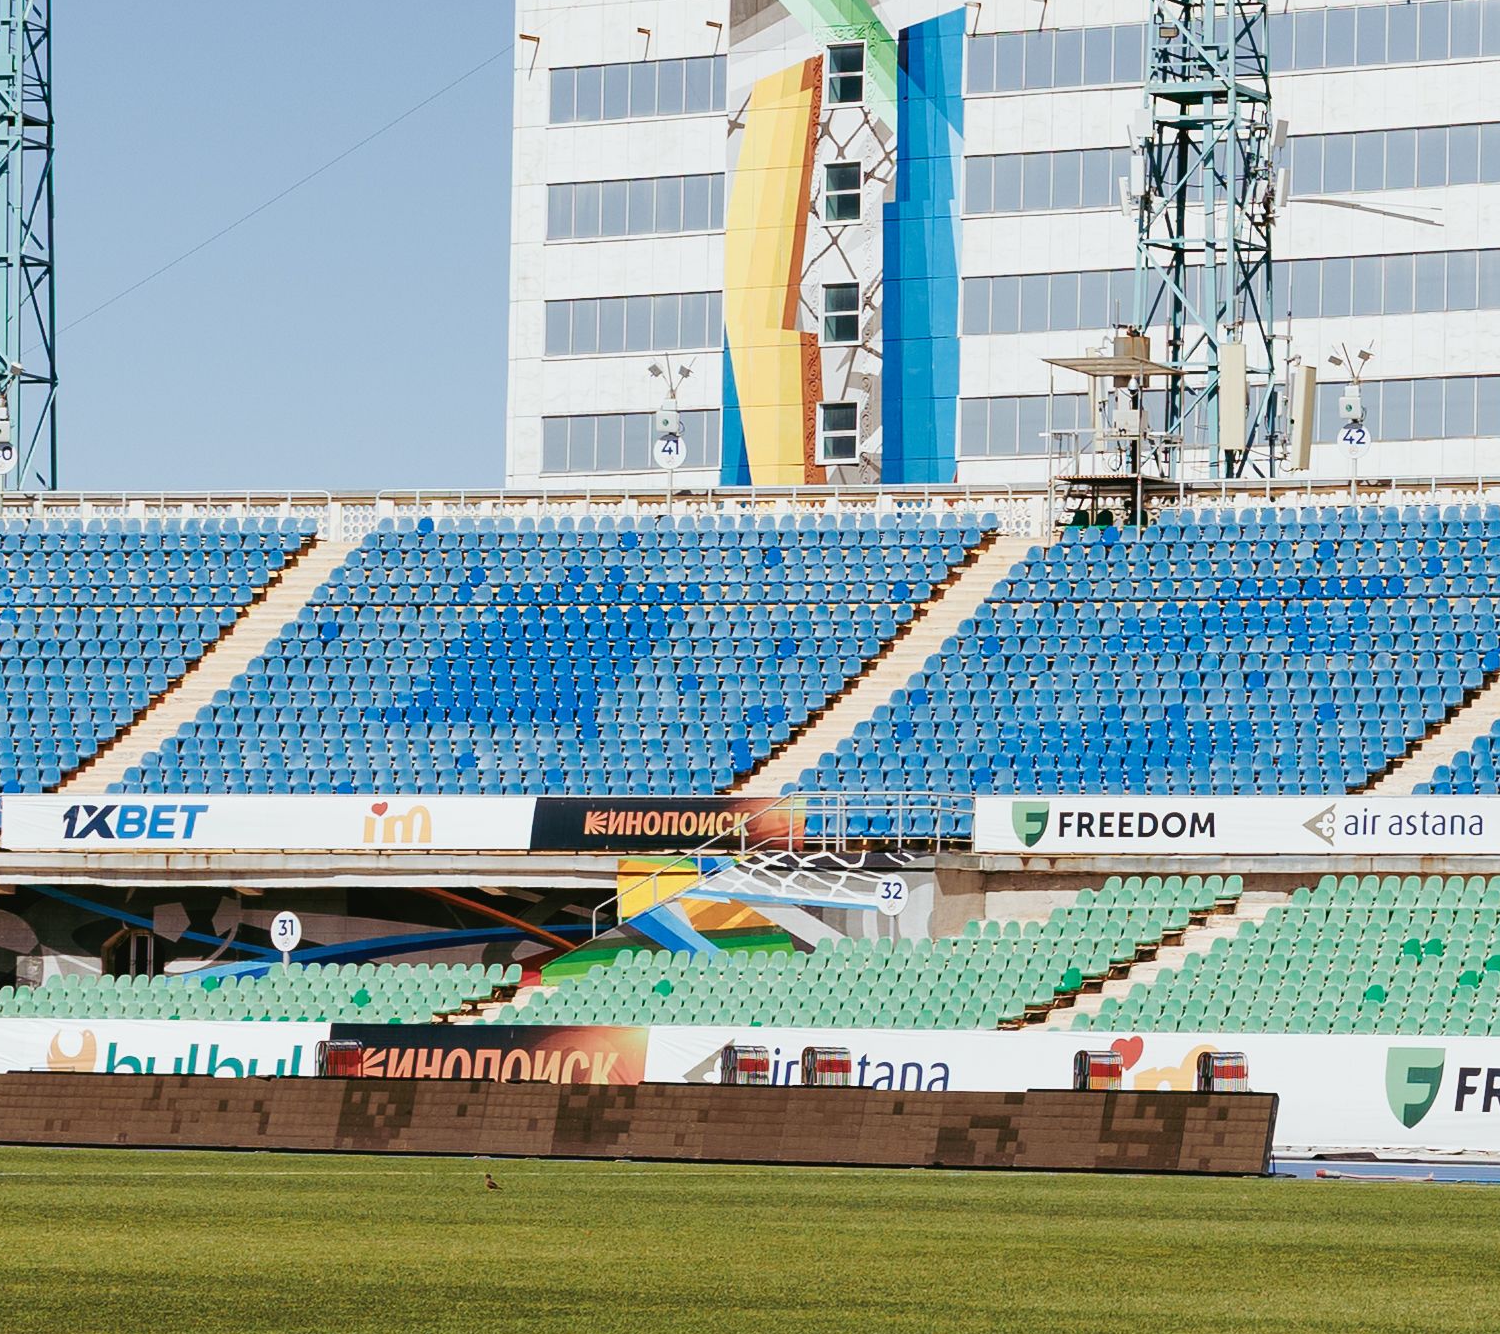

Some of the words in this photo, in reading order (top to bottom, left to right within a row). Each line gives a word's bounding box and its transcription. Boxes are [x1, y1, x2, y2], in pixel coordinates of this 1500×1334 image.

[661, 439, 679, 455] 41
[1342, 428, 1366, 445] 42
[62, 804, 209, 840] 1XBET
[584, 810, 751, 837] КИНОПОИСК
[1058, 811, 1216, 839] FREEDOM
[1343, 807, 1381, 836] air
[1388, 810, 1483, 836] astana
[880, 881, 903, 900] 32
[277, 919, 295, 937] 31
[857, 1053, 950, 1092] tana
